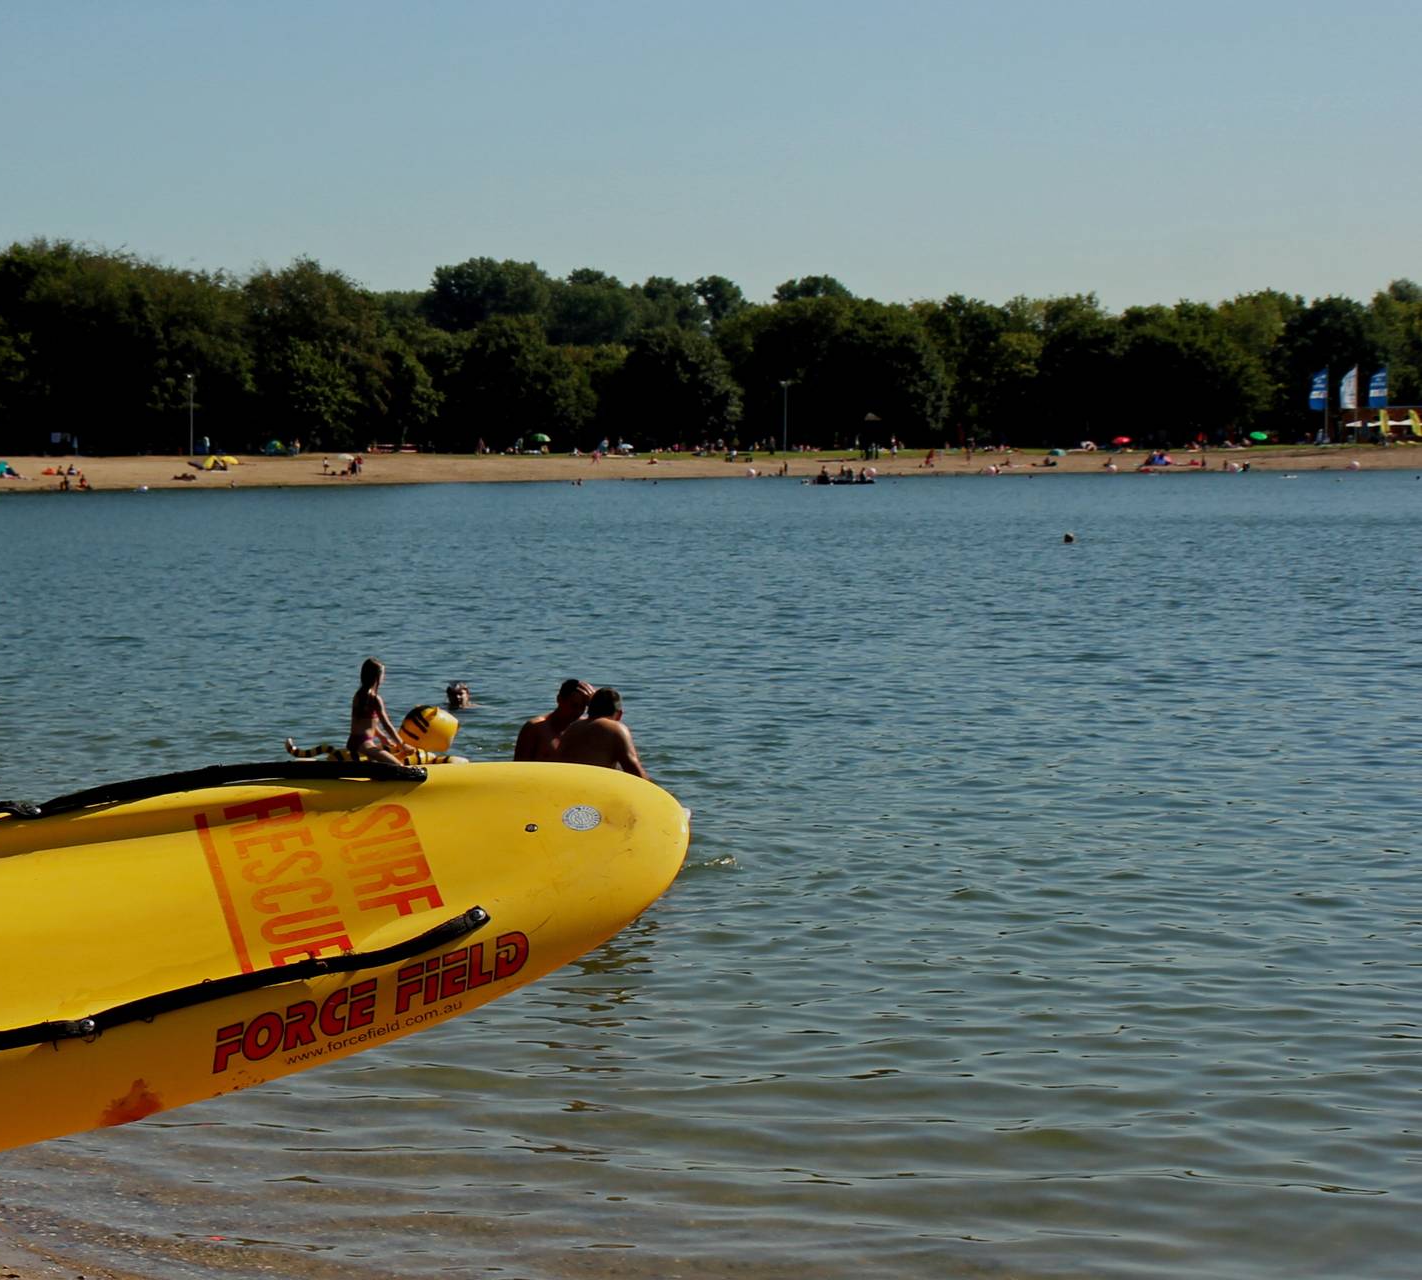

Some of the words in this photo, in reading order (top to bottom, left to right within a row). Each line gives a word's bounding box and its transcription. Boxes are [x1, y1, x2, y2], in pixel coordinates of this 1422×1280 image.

[223, 791, 354, 968] RESCUE
[328, 803, 445, 917] SURF
[212, 978, 378, 1075] FORCE
[395, 930, 530, 1015] FIELD
[285, 1001, 463, 1066] www.forcefield.com.au
